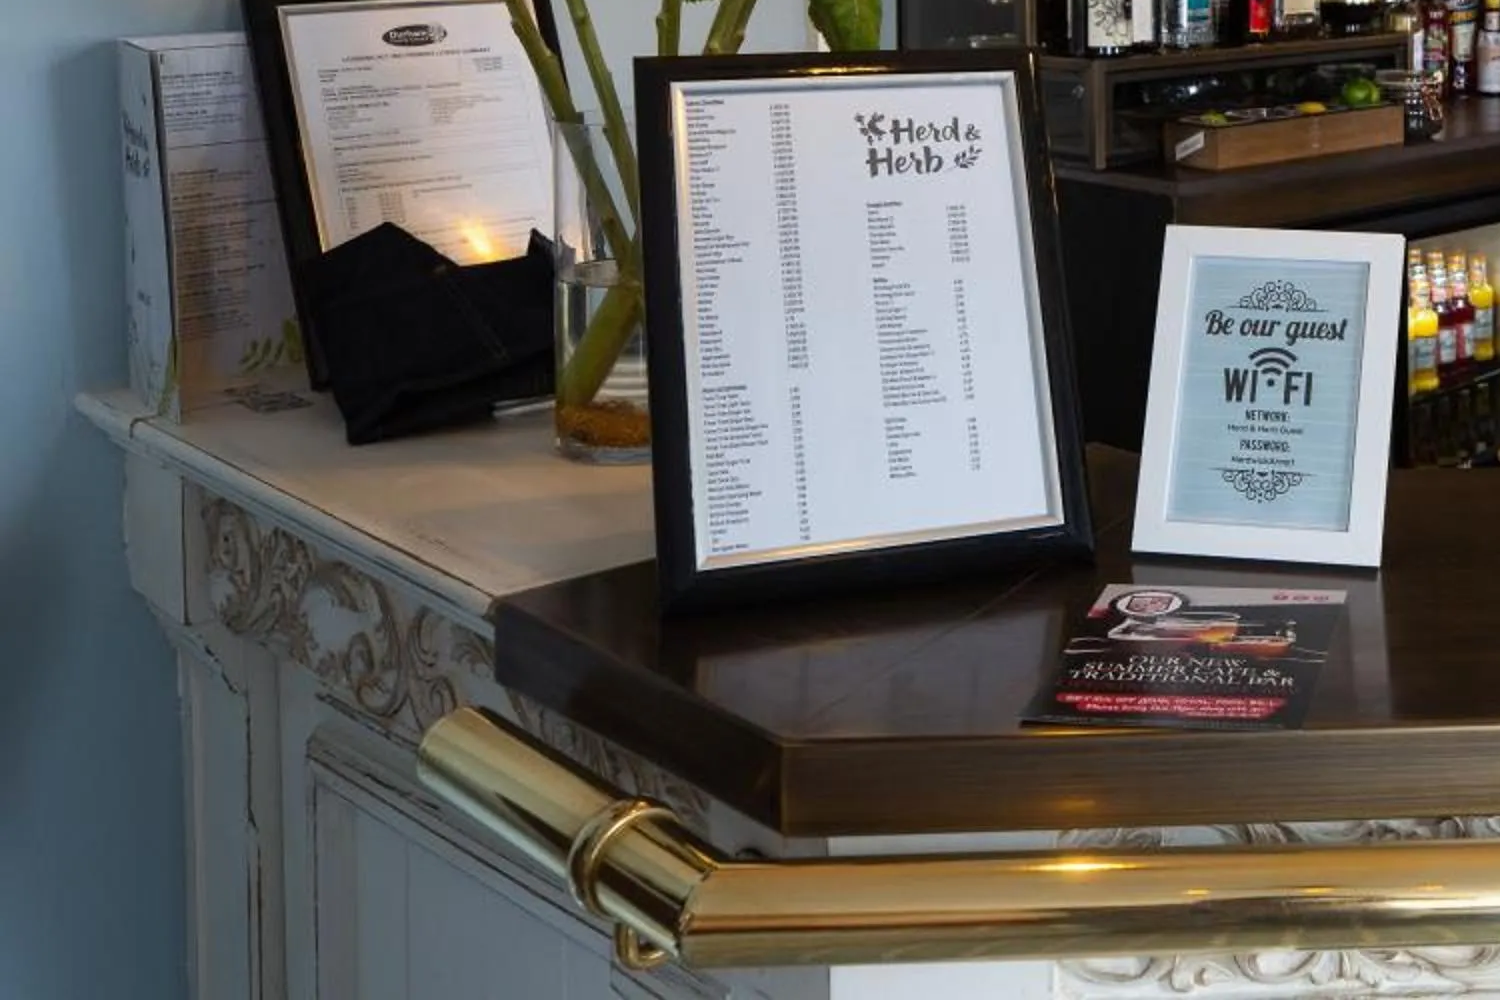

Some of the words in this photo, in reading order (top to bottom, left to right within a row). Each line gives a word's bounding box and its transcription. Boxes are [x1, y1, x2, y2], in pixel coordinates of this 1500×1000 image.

[889, 116, 960, 145] Herd
[965, 123, 981, 142] &
[866, 144, 944, 178] Herb
[1205, 309, 1235, 336] Be
[1239, 319, 1281, 338] our
[1286, 317, 1349, 346] guest
[1245, 409, 1290, 422] NETWORK:
[1239, 439, 1290, 453] PASSWORD:
[1083, 661, 1186, 675] SUMMER
[1263, 668, 1281, 678] &
[1129, 655, 1181, 667] OUR
[1190, 656, 1247, 668] NEW
[1069, 670, 1242, 686] TRADITIONAL
[1248, 676, 1294, 688] BAR
